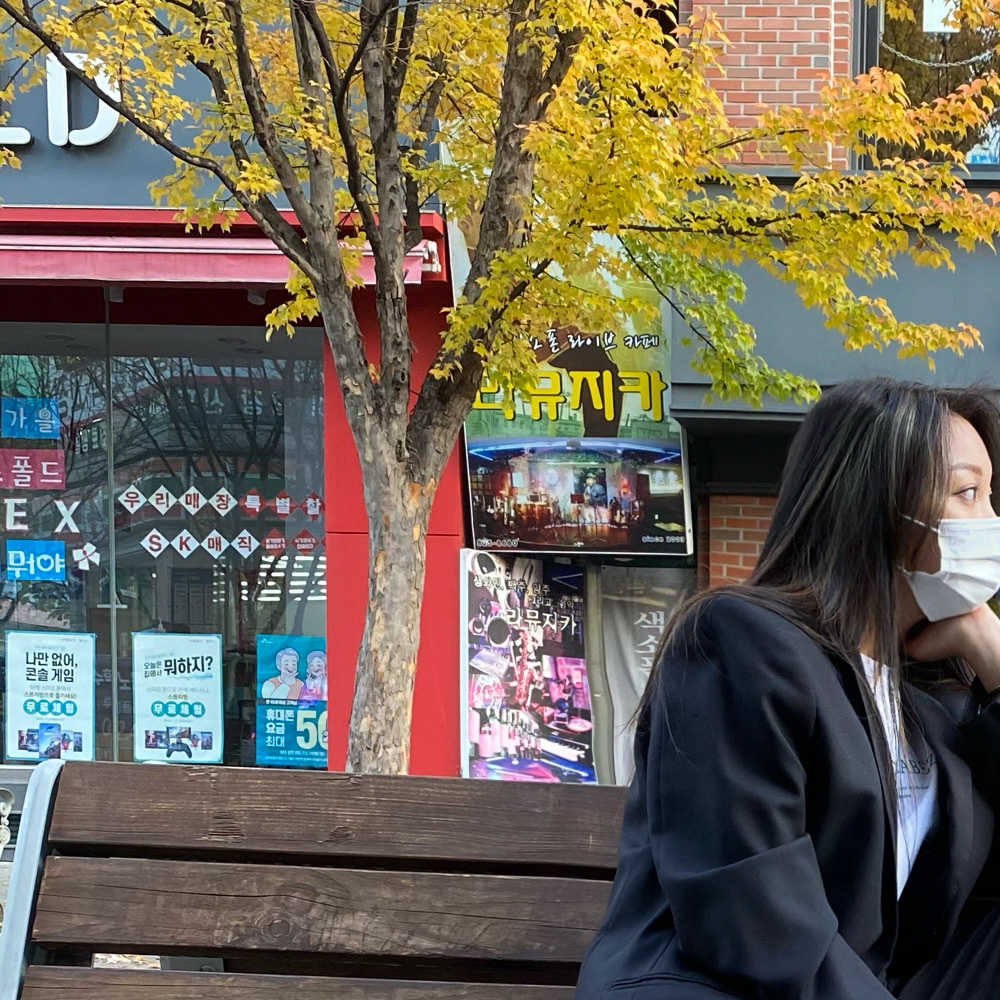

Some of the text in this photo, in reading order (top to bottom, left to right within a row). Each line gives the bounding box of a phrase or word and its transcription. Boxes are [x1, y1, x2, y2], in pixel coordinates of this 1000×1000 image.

[567, 331, 617, 351] 라이브
[624, 334, 660, 349] 카페
[5, 408, 56, 434] 가을
[0, 456, 63, 487] 폴드
[123, 490, 231, 510] 우리매장
[505, 609, 578, 636] 라뮤지카
[26, 652, 78, 668] 나만 없어,
[144, 661, 162, 670] 오늘은
[163, 656, 214, 676] 뭐하지?
[26, 667, 74, 683] 콘솔 게임
[26, 701, 74, 714] 무료체험
[154, 703, 201, 715] 무료체험
[265, 709, 295, 722] 휴대폰
[265, 722, 286, 735] 요금
[265, 736, 286, 748] 최대
